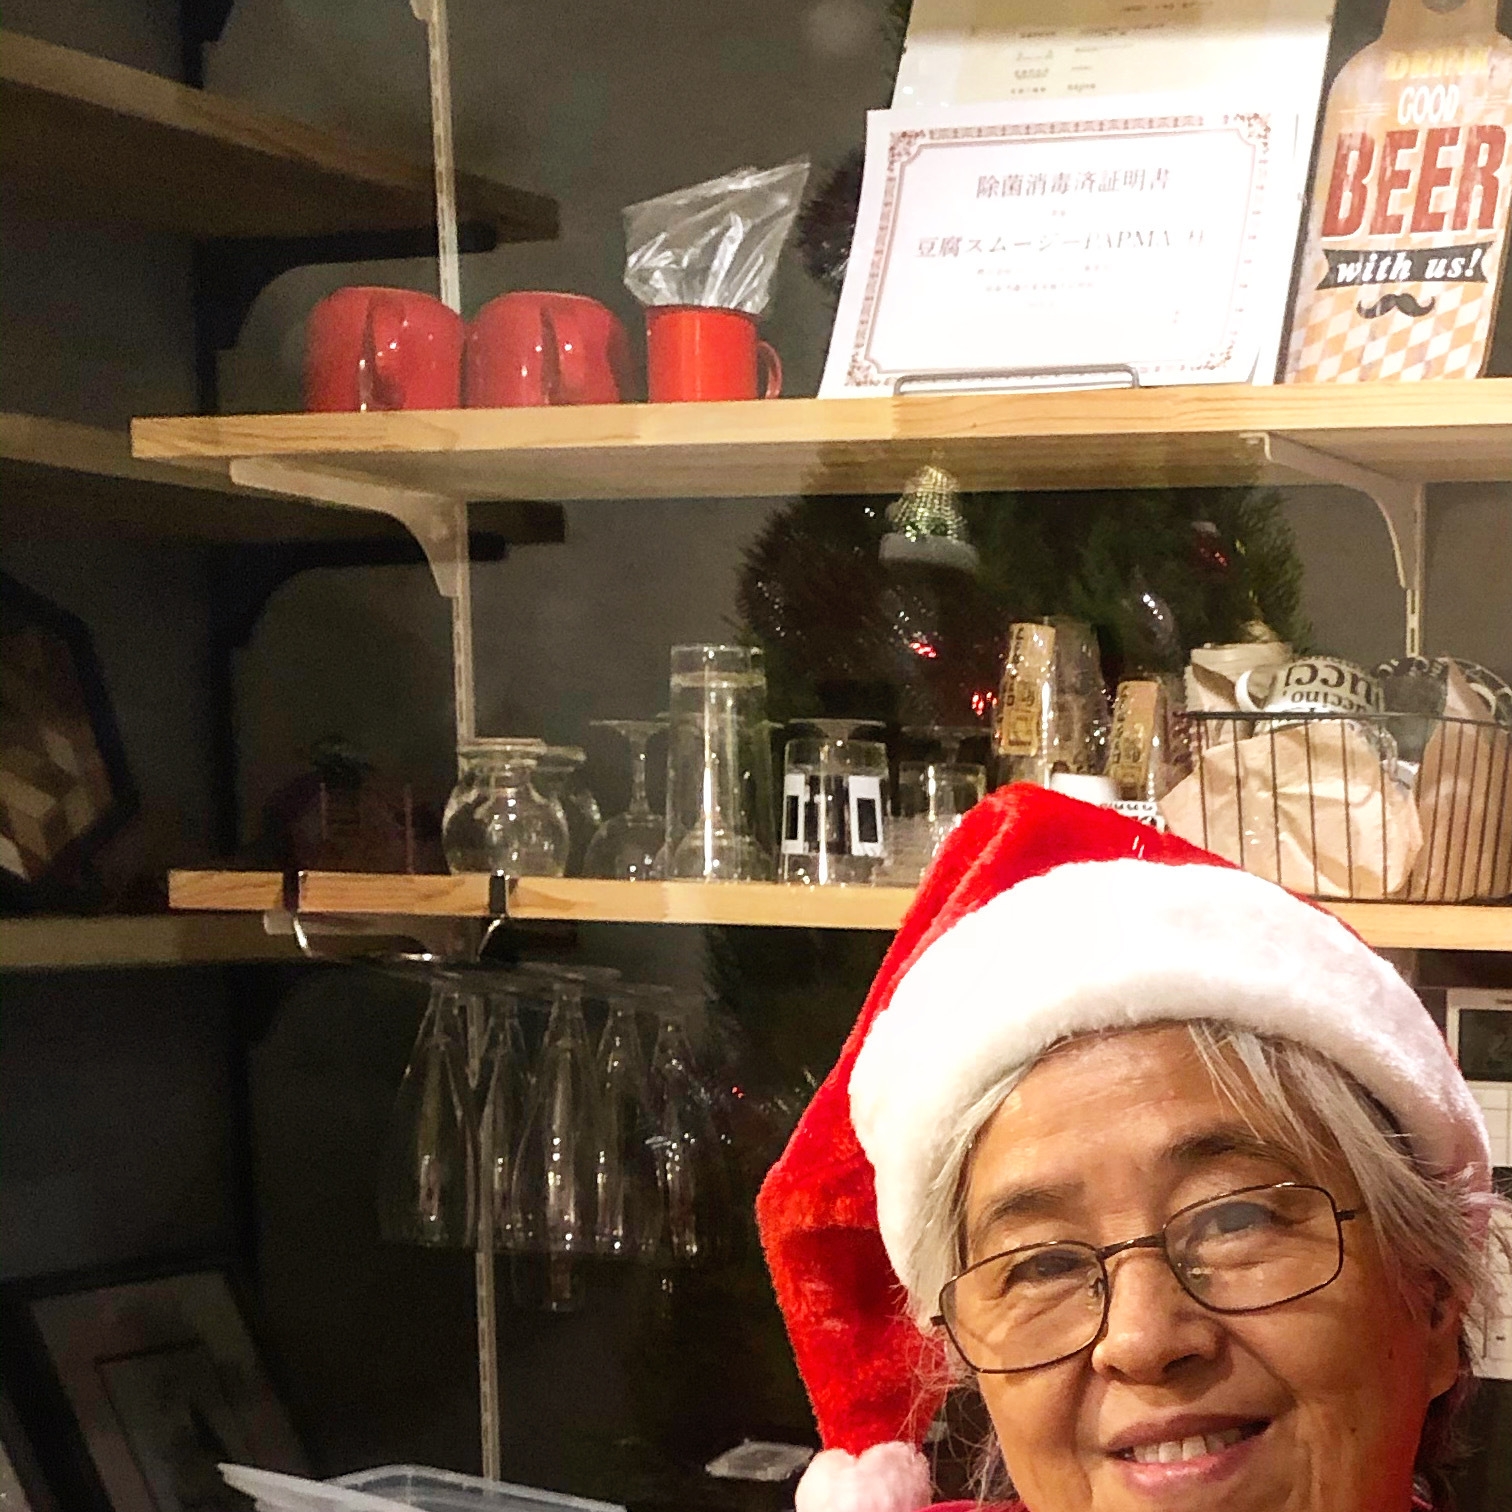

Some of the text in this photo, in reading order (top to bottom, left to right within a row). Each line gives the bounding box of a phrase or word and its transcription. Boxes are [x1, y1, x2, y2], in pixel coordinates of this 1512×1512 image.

[1397, 84, 1460, 124] GOOD
[1321, 125, 1507, 239] BEER
[1336, 247, 1483, 283] with us!
